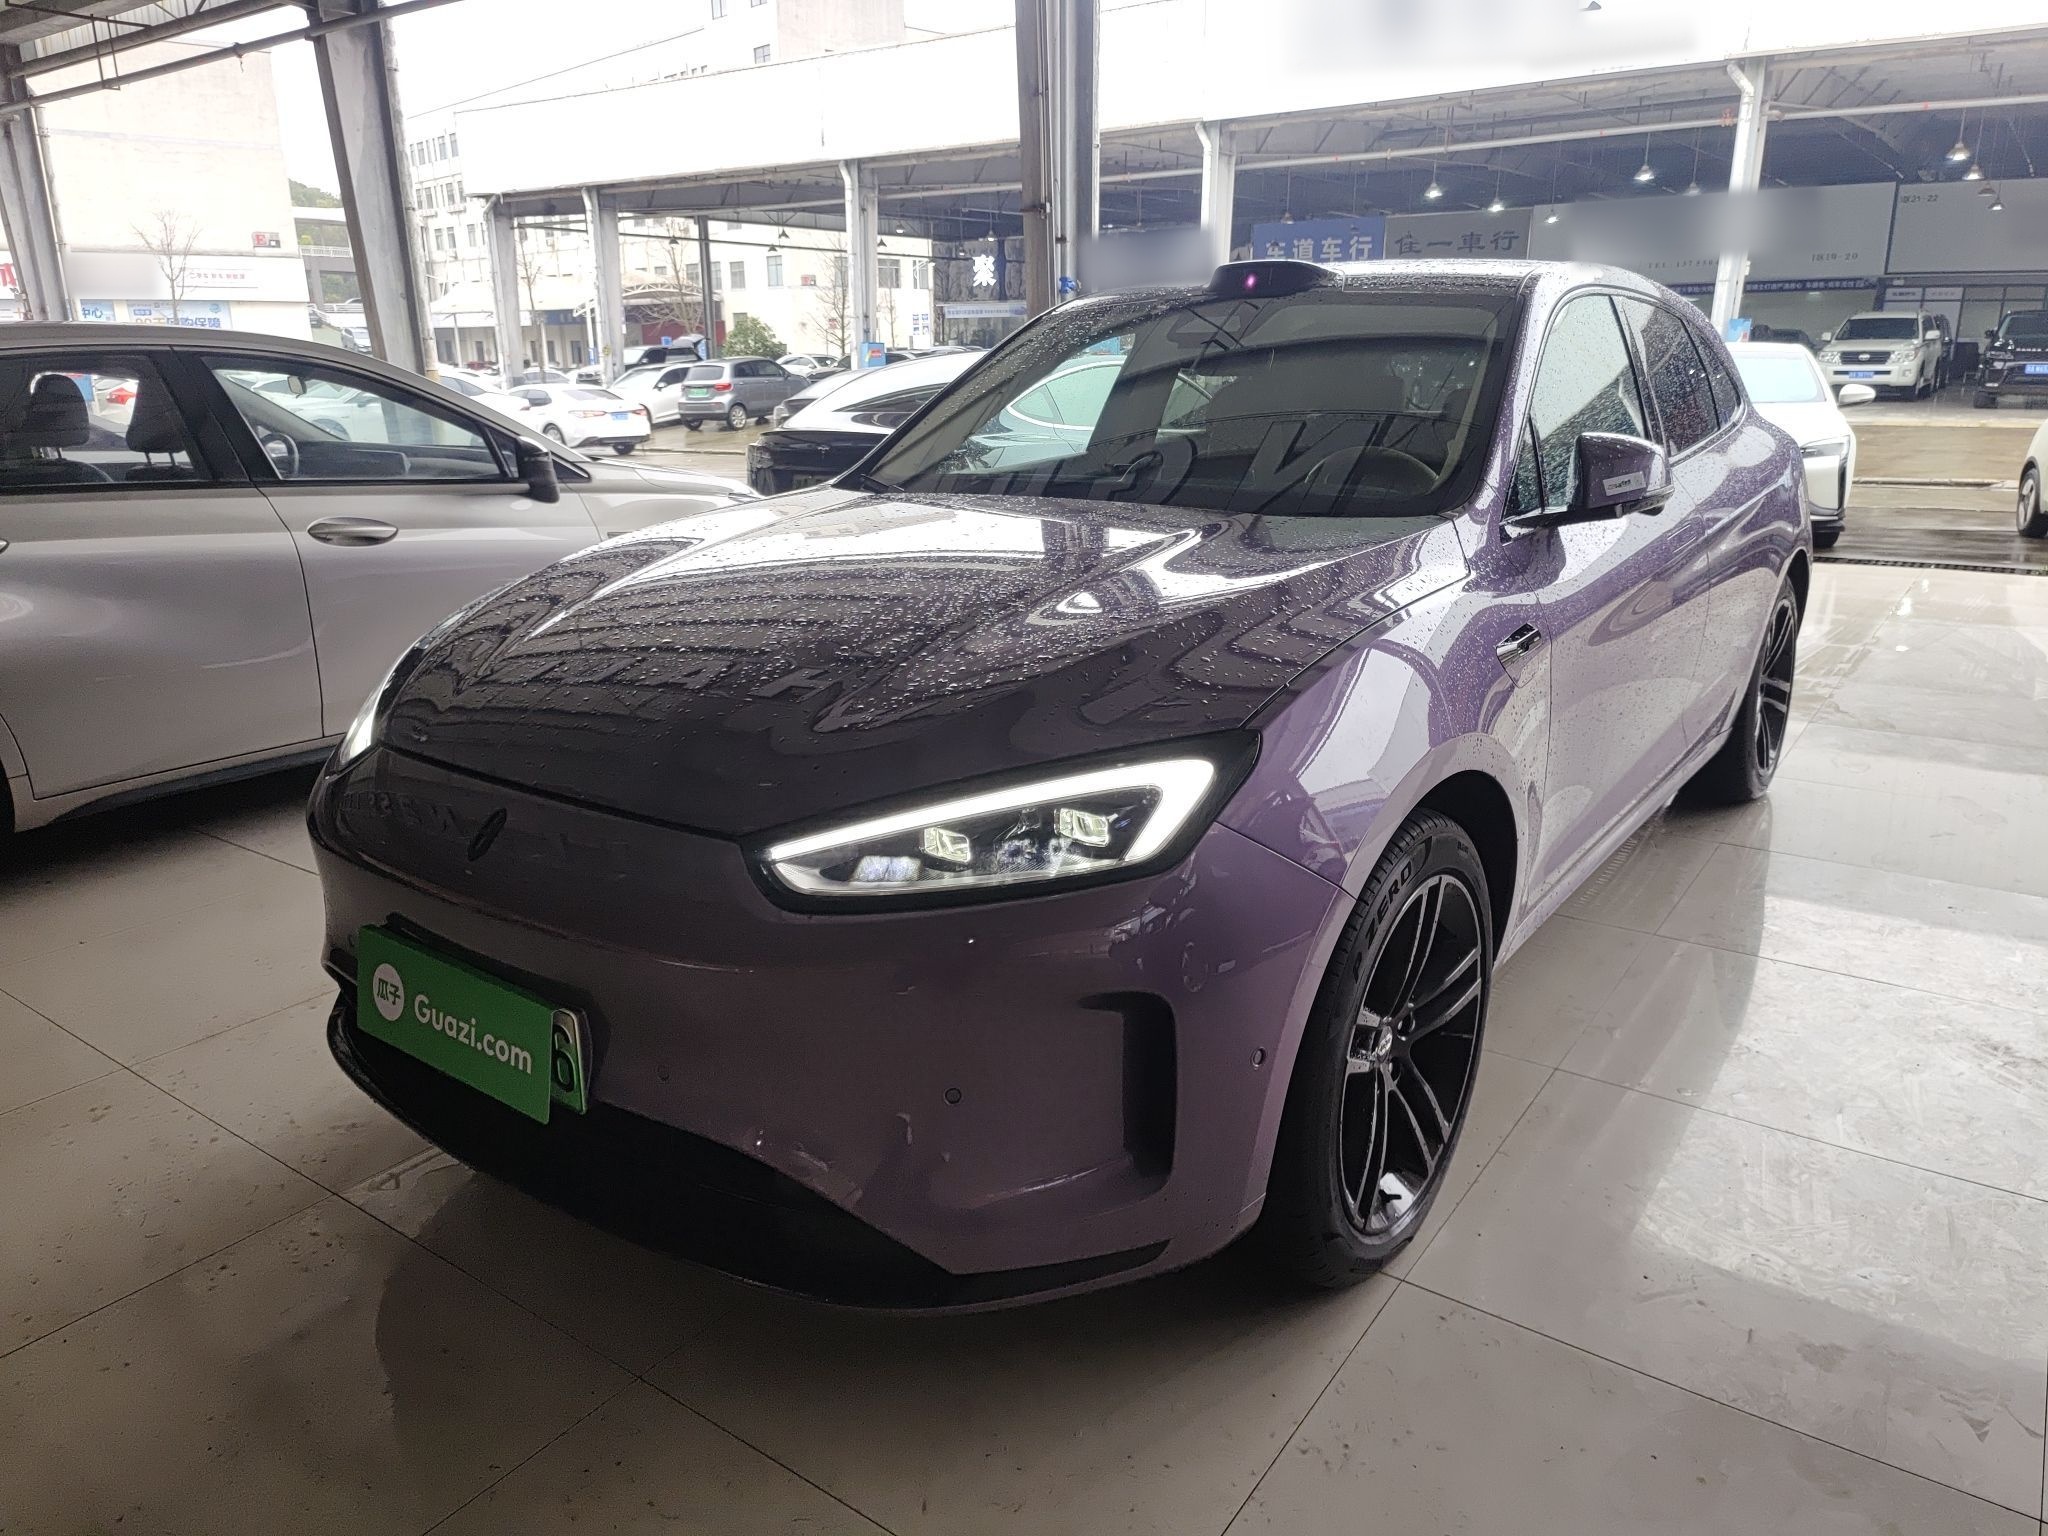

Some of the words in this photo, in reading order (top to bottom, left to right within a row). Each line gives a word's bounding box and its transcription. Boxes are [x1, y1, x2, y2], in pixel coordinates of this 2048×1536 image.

[1352, 951, 1363, 984] P
[1365, 861, 1413, 950] ZERO
[376, 977, 402, 1006] 瓜子
[414, 994, 532, 1075] Guazi.com
